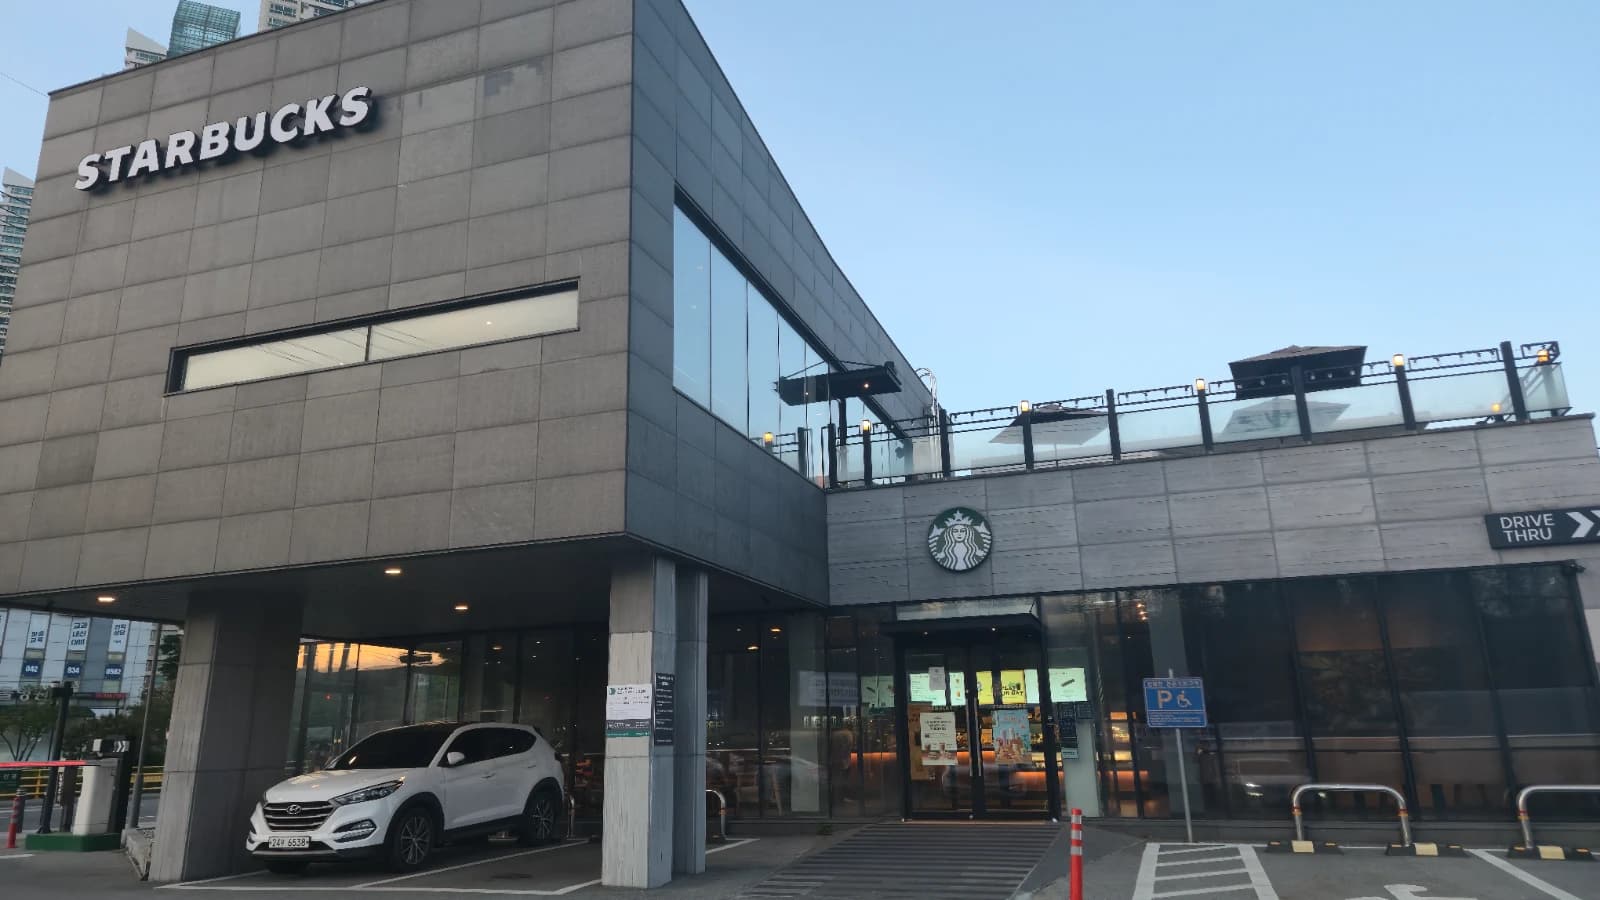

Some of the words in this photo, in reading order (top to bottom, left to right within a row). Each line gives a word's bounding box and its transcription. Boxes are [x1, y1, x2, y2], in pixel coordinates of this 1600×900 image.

[74, 86, 369, 190] STARBUCKS
[1500, 513, 1555, 529] DRIVE
[1503, 528, 1553, 542] THRU
[1157, 689, 1172, 709] P
[288, 839, 305, 847] 6538
